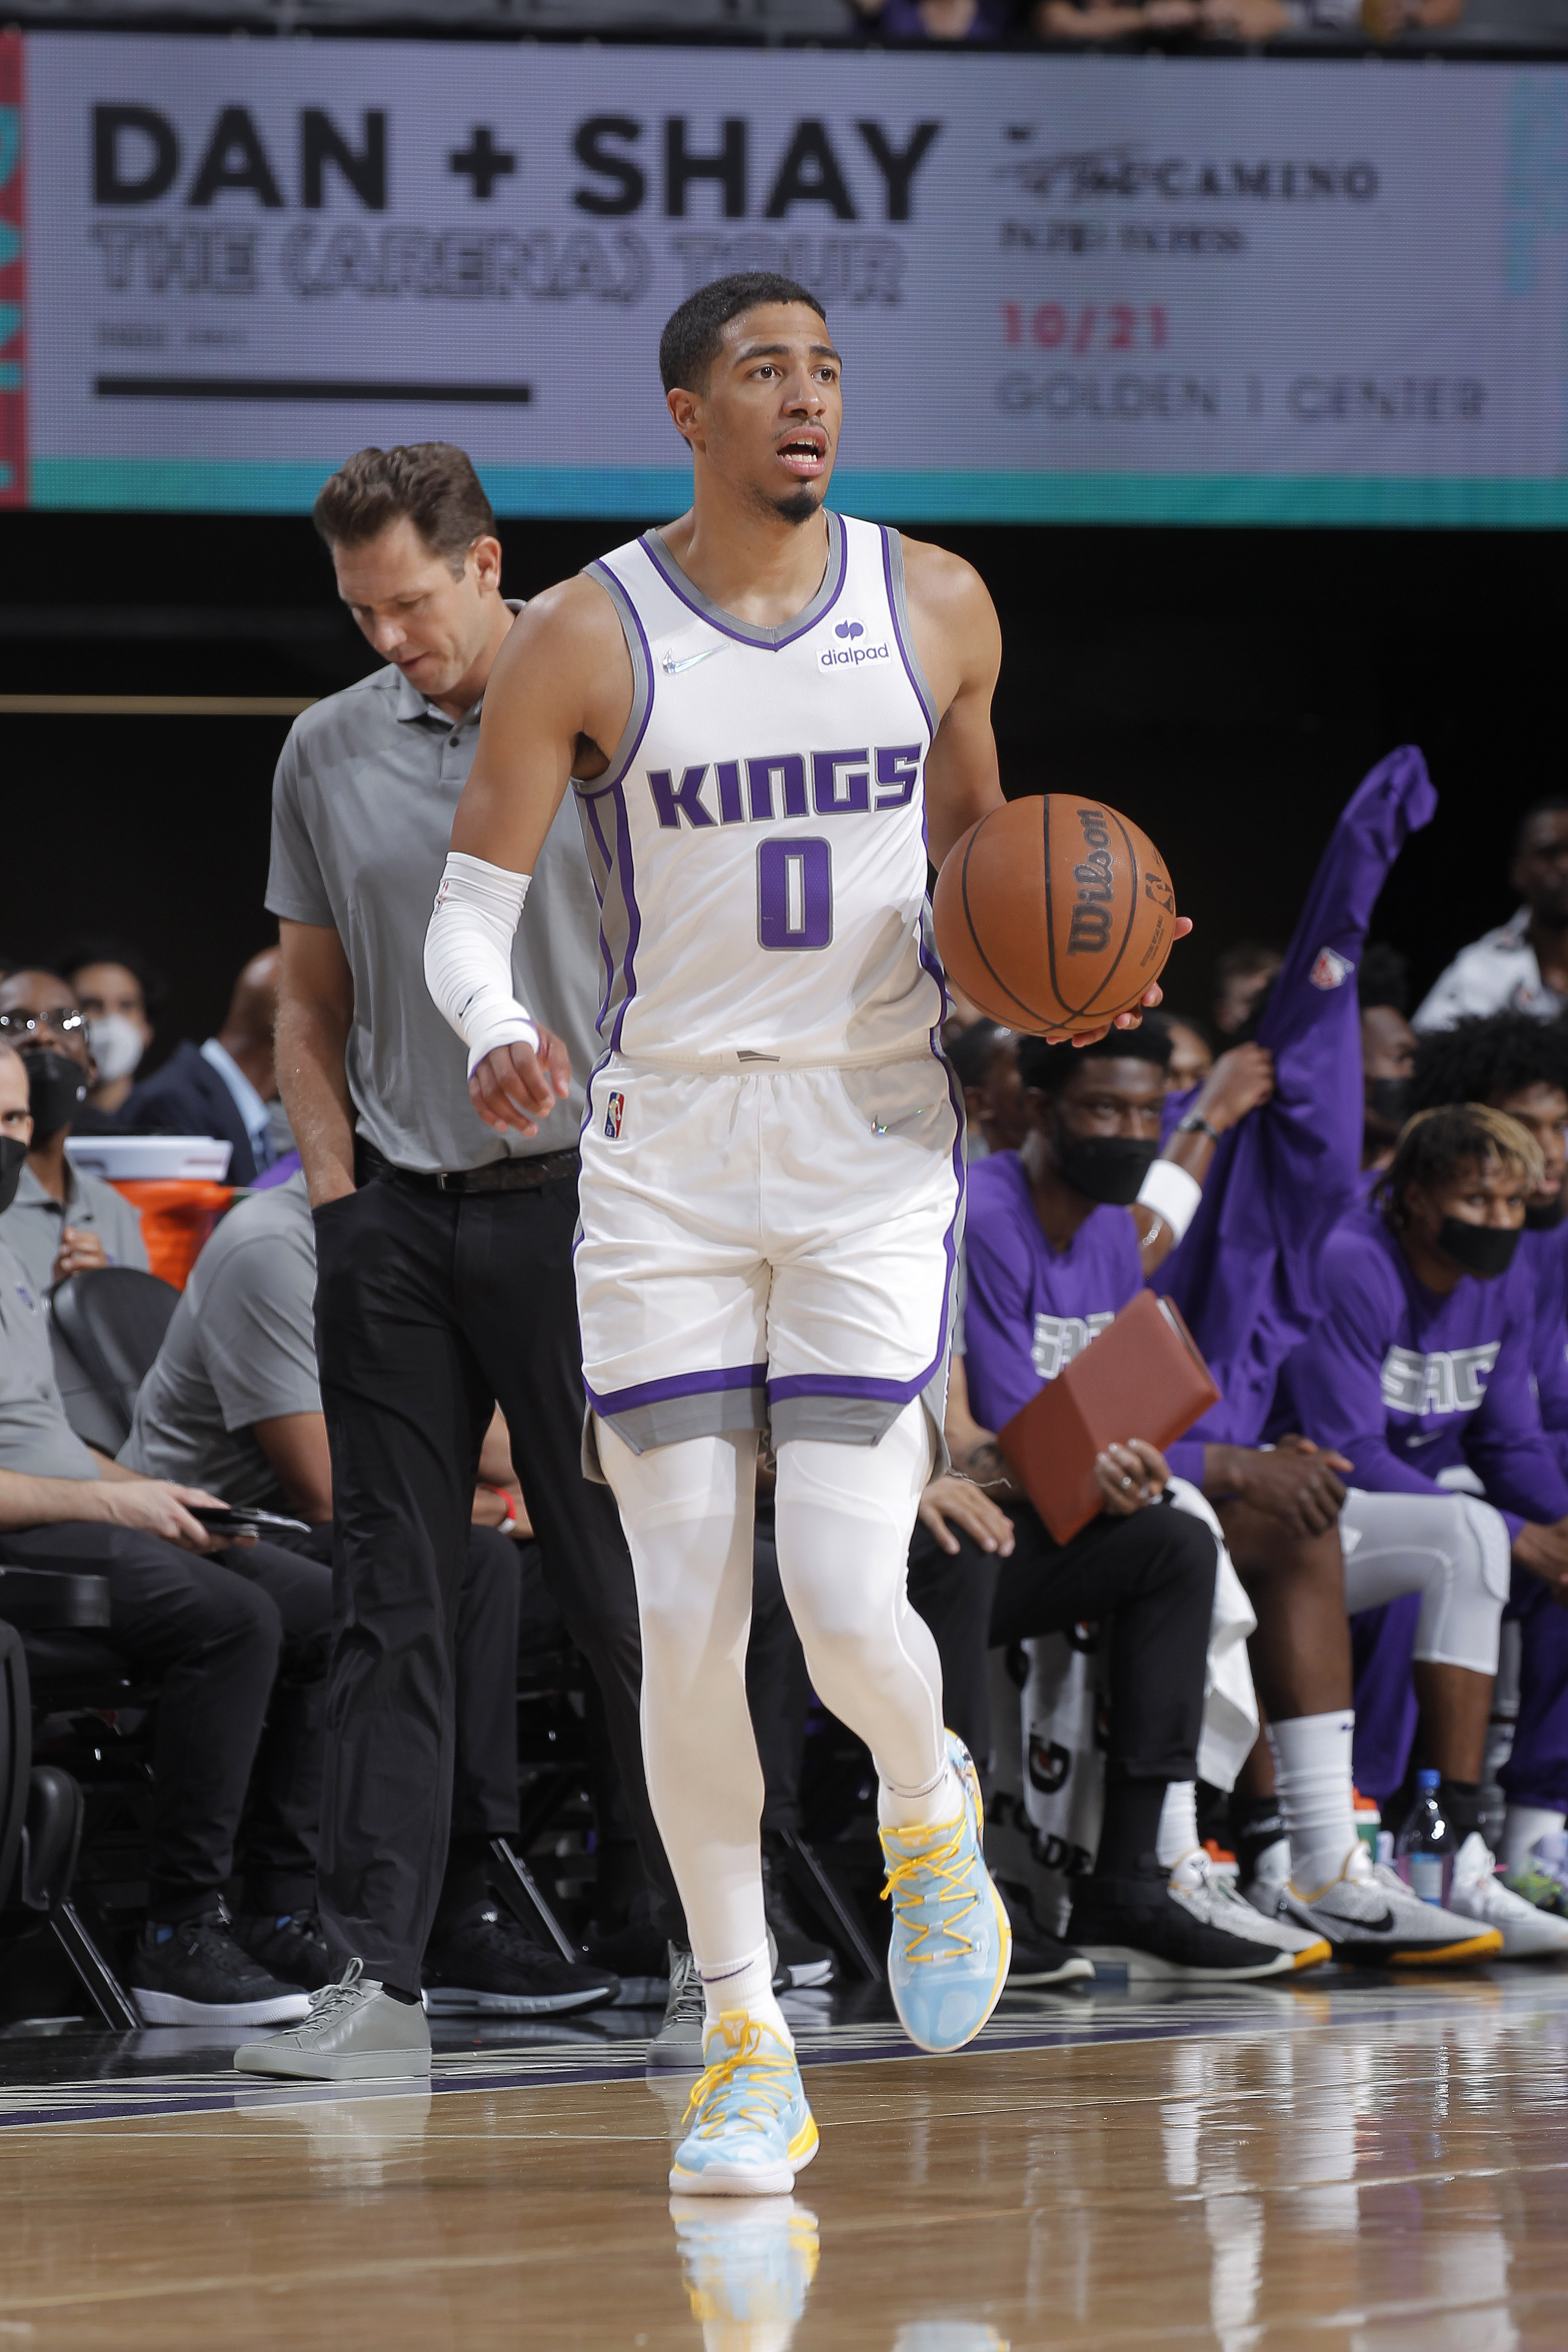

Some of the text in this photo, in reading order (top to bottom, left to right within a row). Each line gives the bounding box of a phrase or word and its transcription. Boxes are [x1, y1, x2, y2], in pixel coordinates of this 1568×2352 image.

[93, 103, 386, 211] DAN
[575, 115, 940, 221] SHAY
[1155, 159, 1380, 202] CAMINO
[90, 225, 257, 294] THE
[1000, 301, 1168, 358] 10/21
[997, 374, 1220, 417] GOLDEN
[821, 642, 890, 669] dialpad
[645, 743, 922, 830] KINGS
[756, 836, 833, 952] 0
[1067, 808, 1115, 956] Wilson
[1380, 1340, 1501, 1416] SAC
